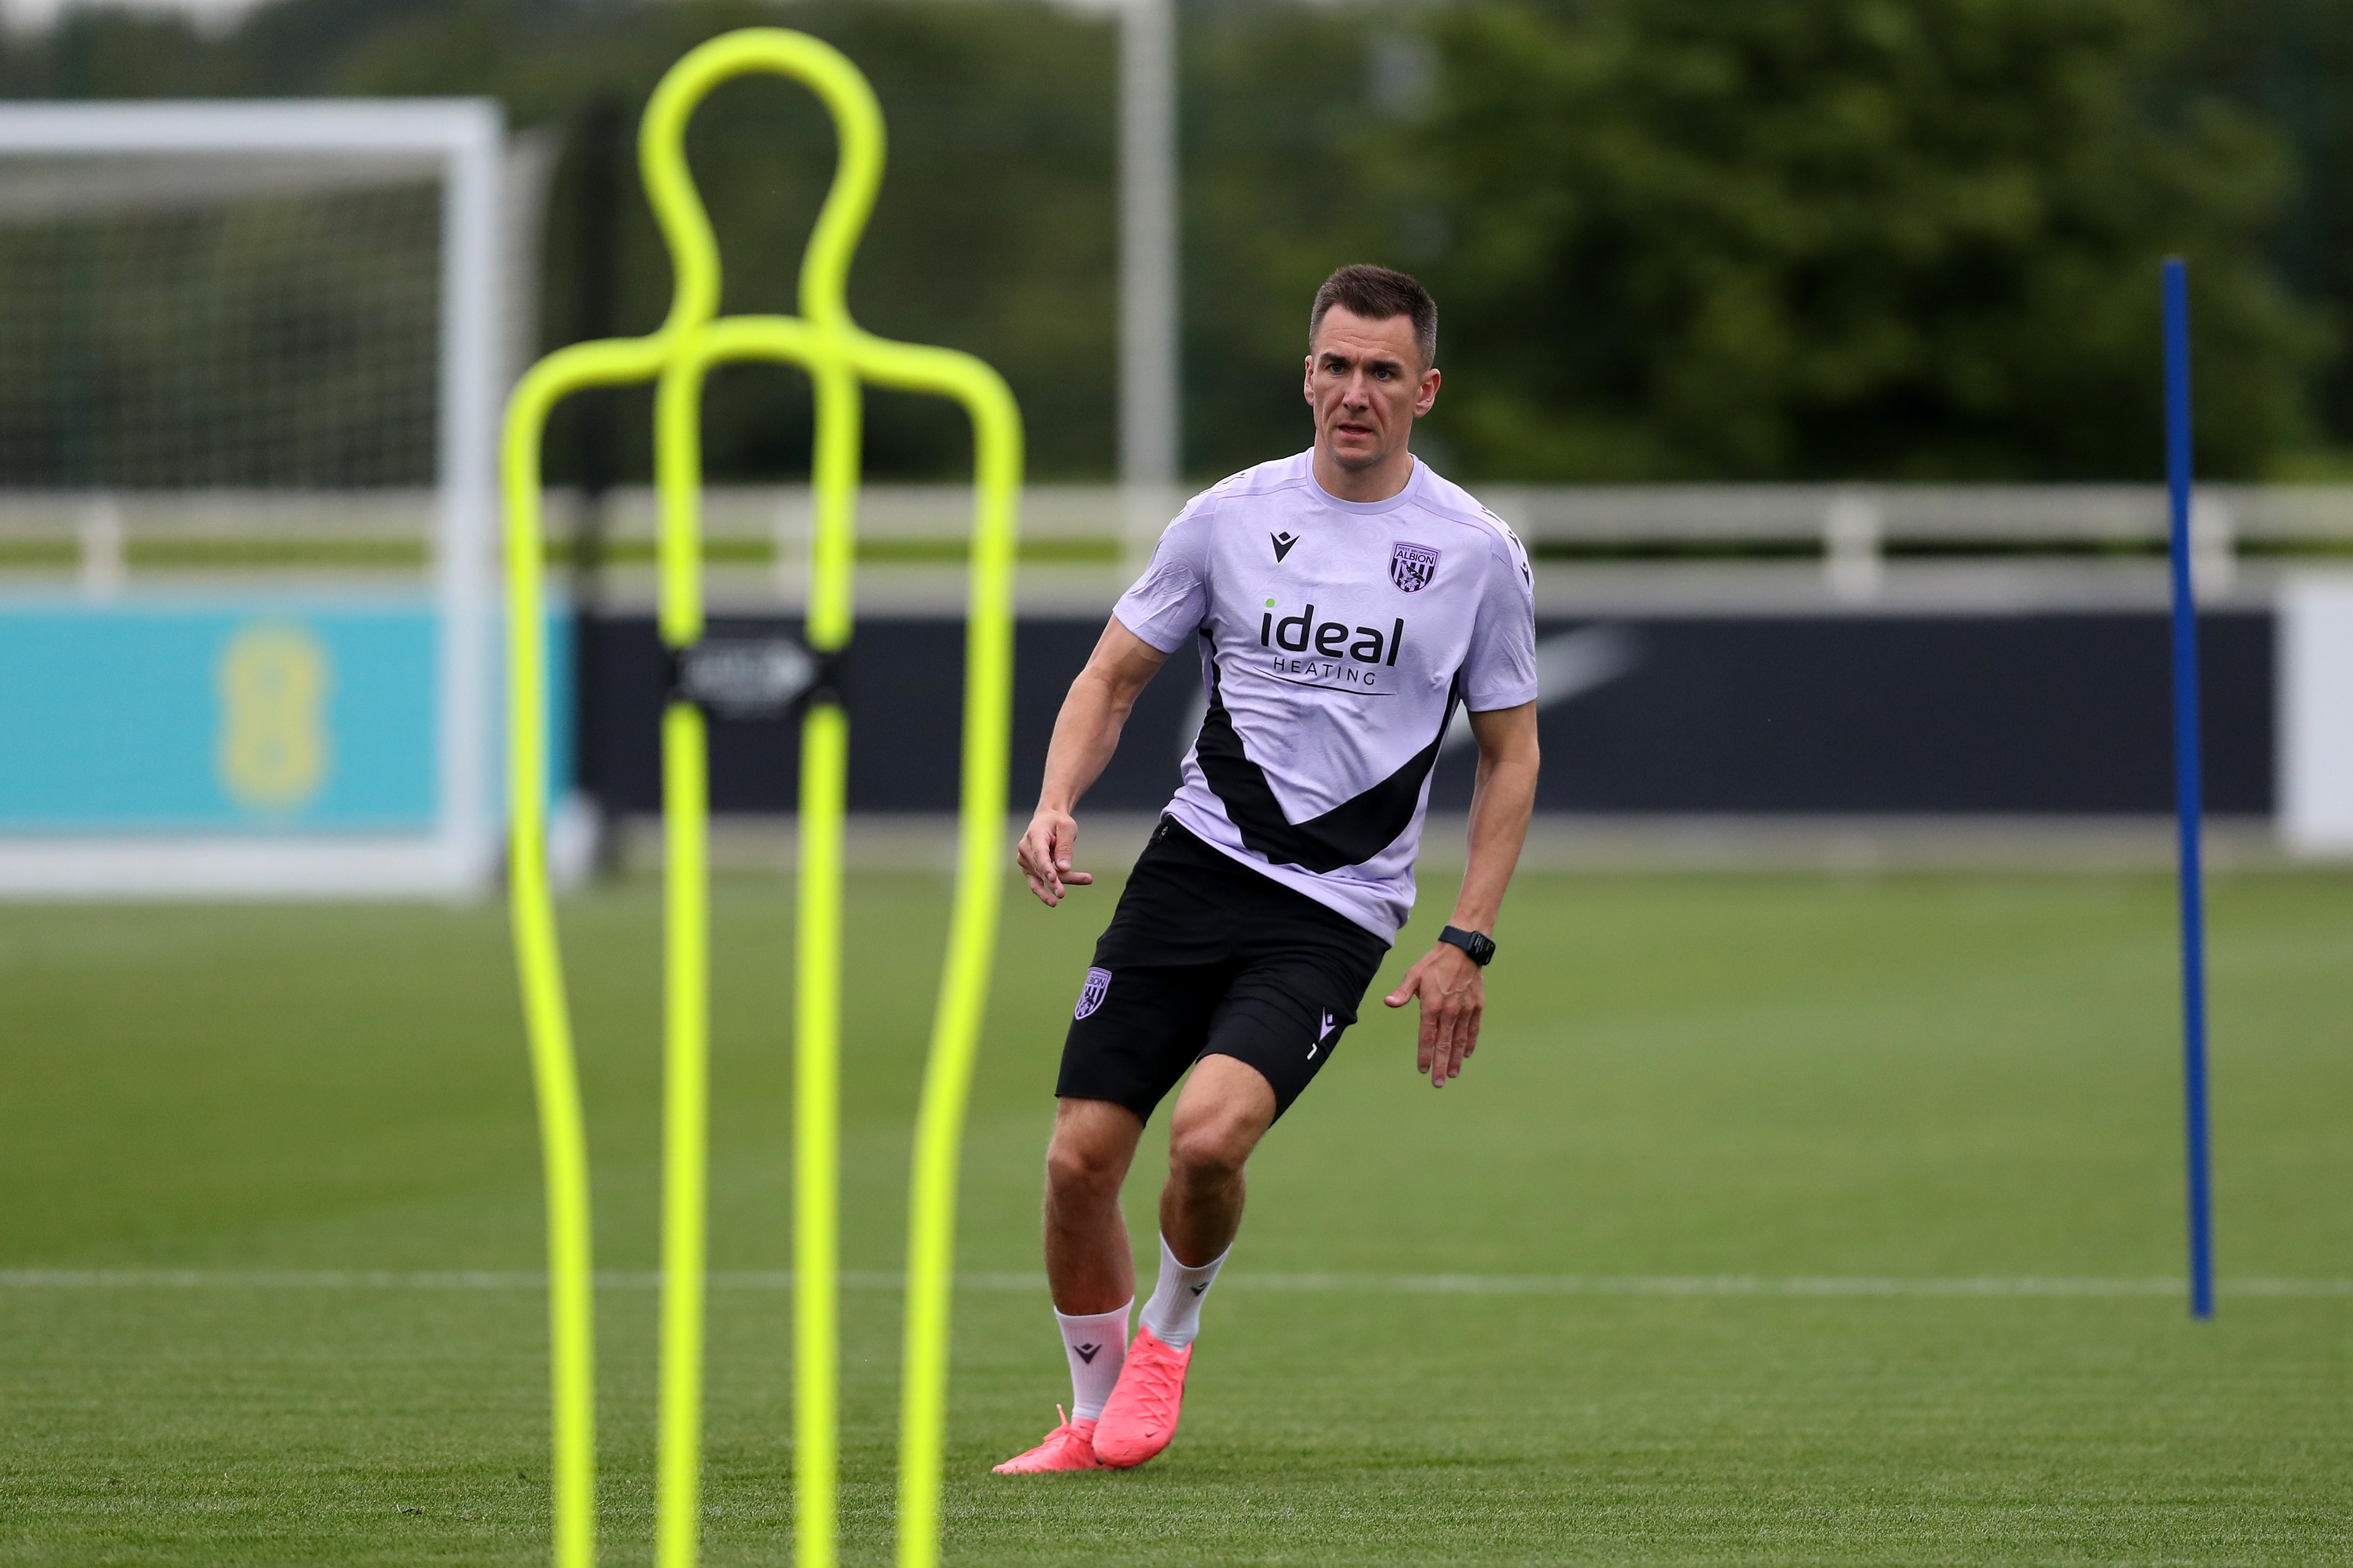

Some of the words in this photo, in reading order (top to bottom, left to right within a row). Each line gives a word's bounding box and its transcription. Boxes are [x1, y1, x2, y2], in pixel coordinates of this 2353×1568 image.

[1396, 550, 1435, 564] ALBION
[1411, 549, 1436, 557] BROMWICH
[1261, 598, 1404, 666] ideal
[1274, 657, 1376, 685] HEATING
